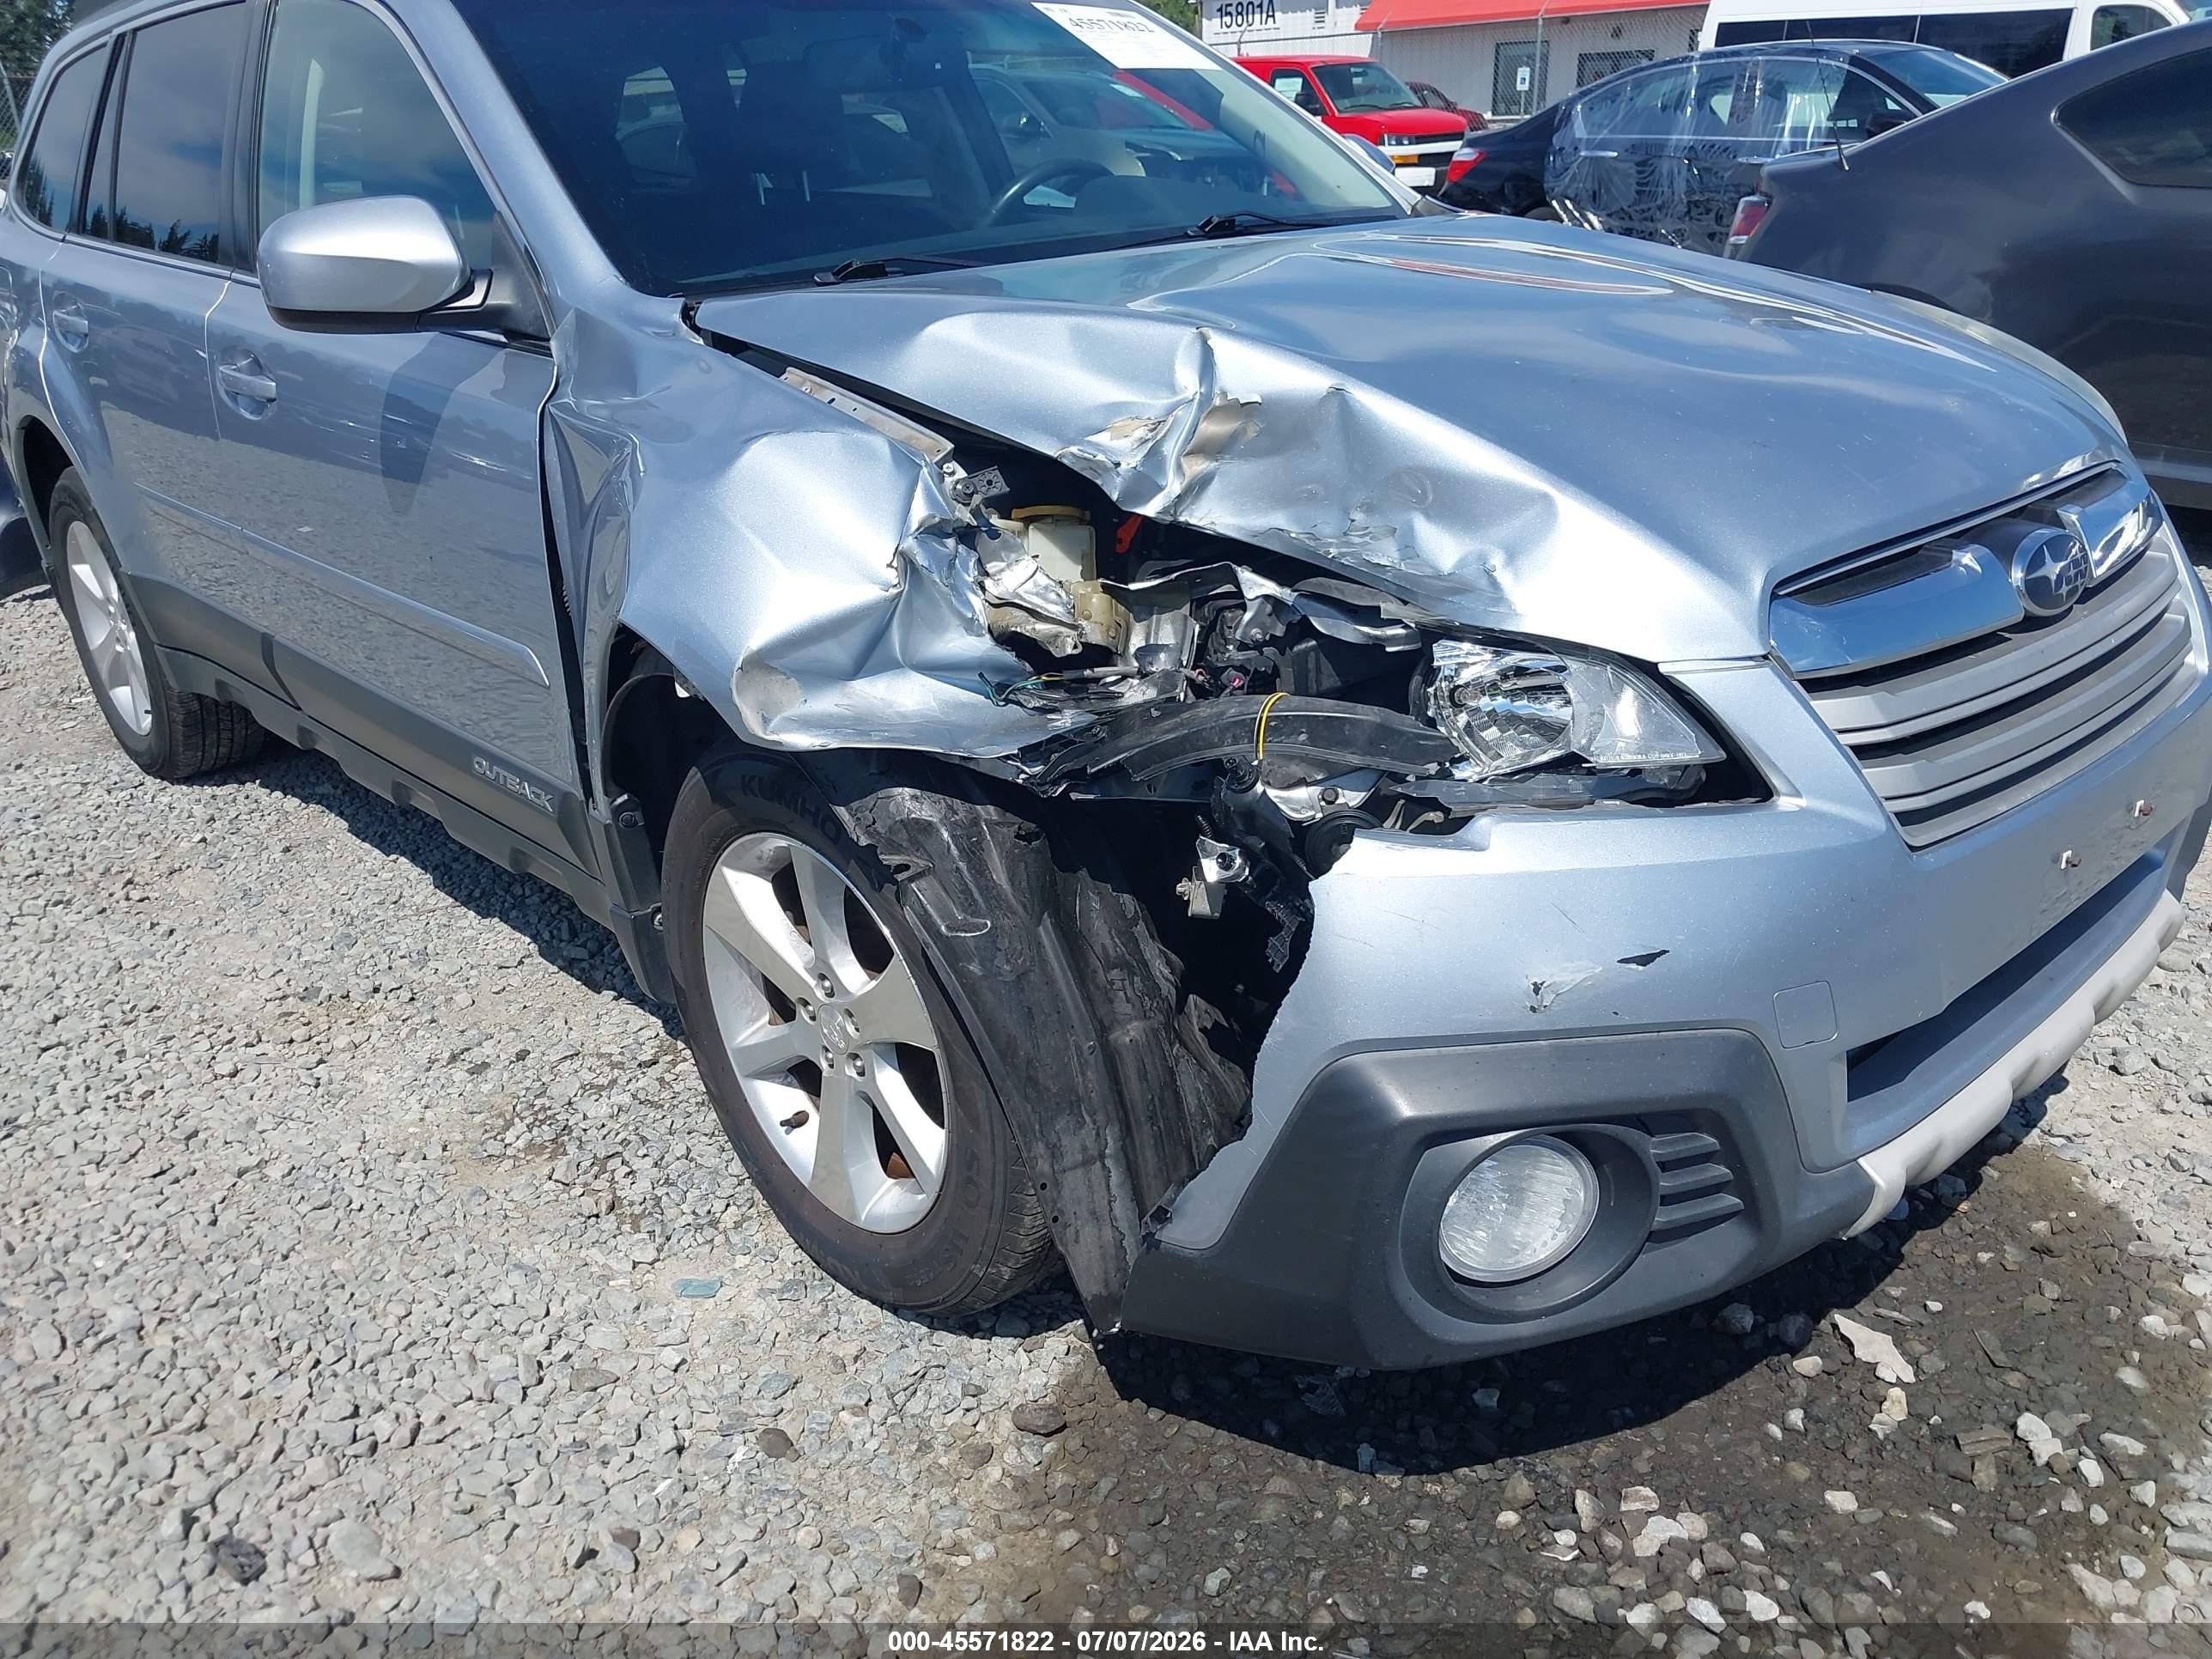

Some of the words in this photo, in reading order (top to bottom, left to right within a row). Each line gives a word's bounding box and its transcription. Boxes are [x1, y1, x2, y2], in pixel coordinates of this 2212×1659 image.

[1068, 16, 1156, 33] 45571822
[1216, 0, 1276, 29] 15801A
[473, 757, 554, 812] OUTBACK
[741, 774, 842, 845] KUMHO
